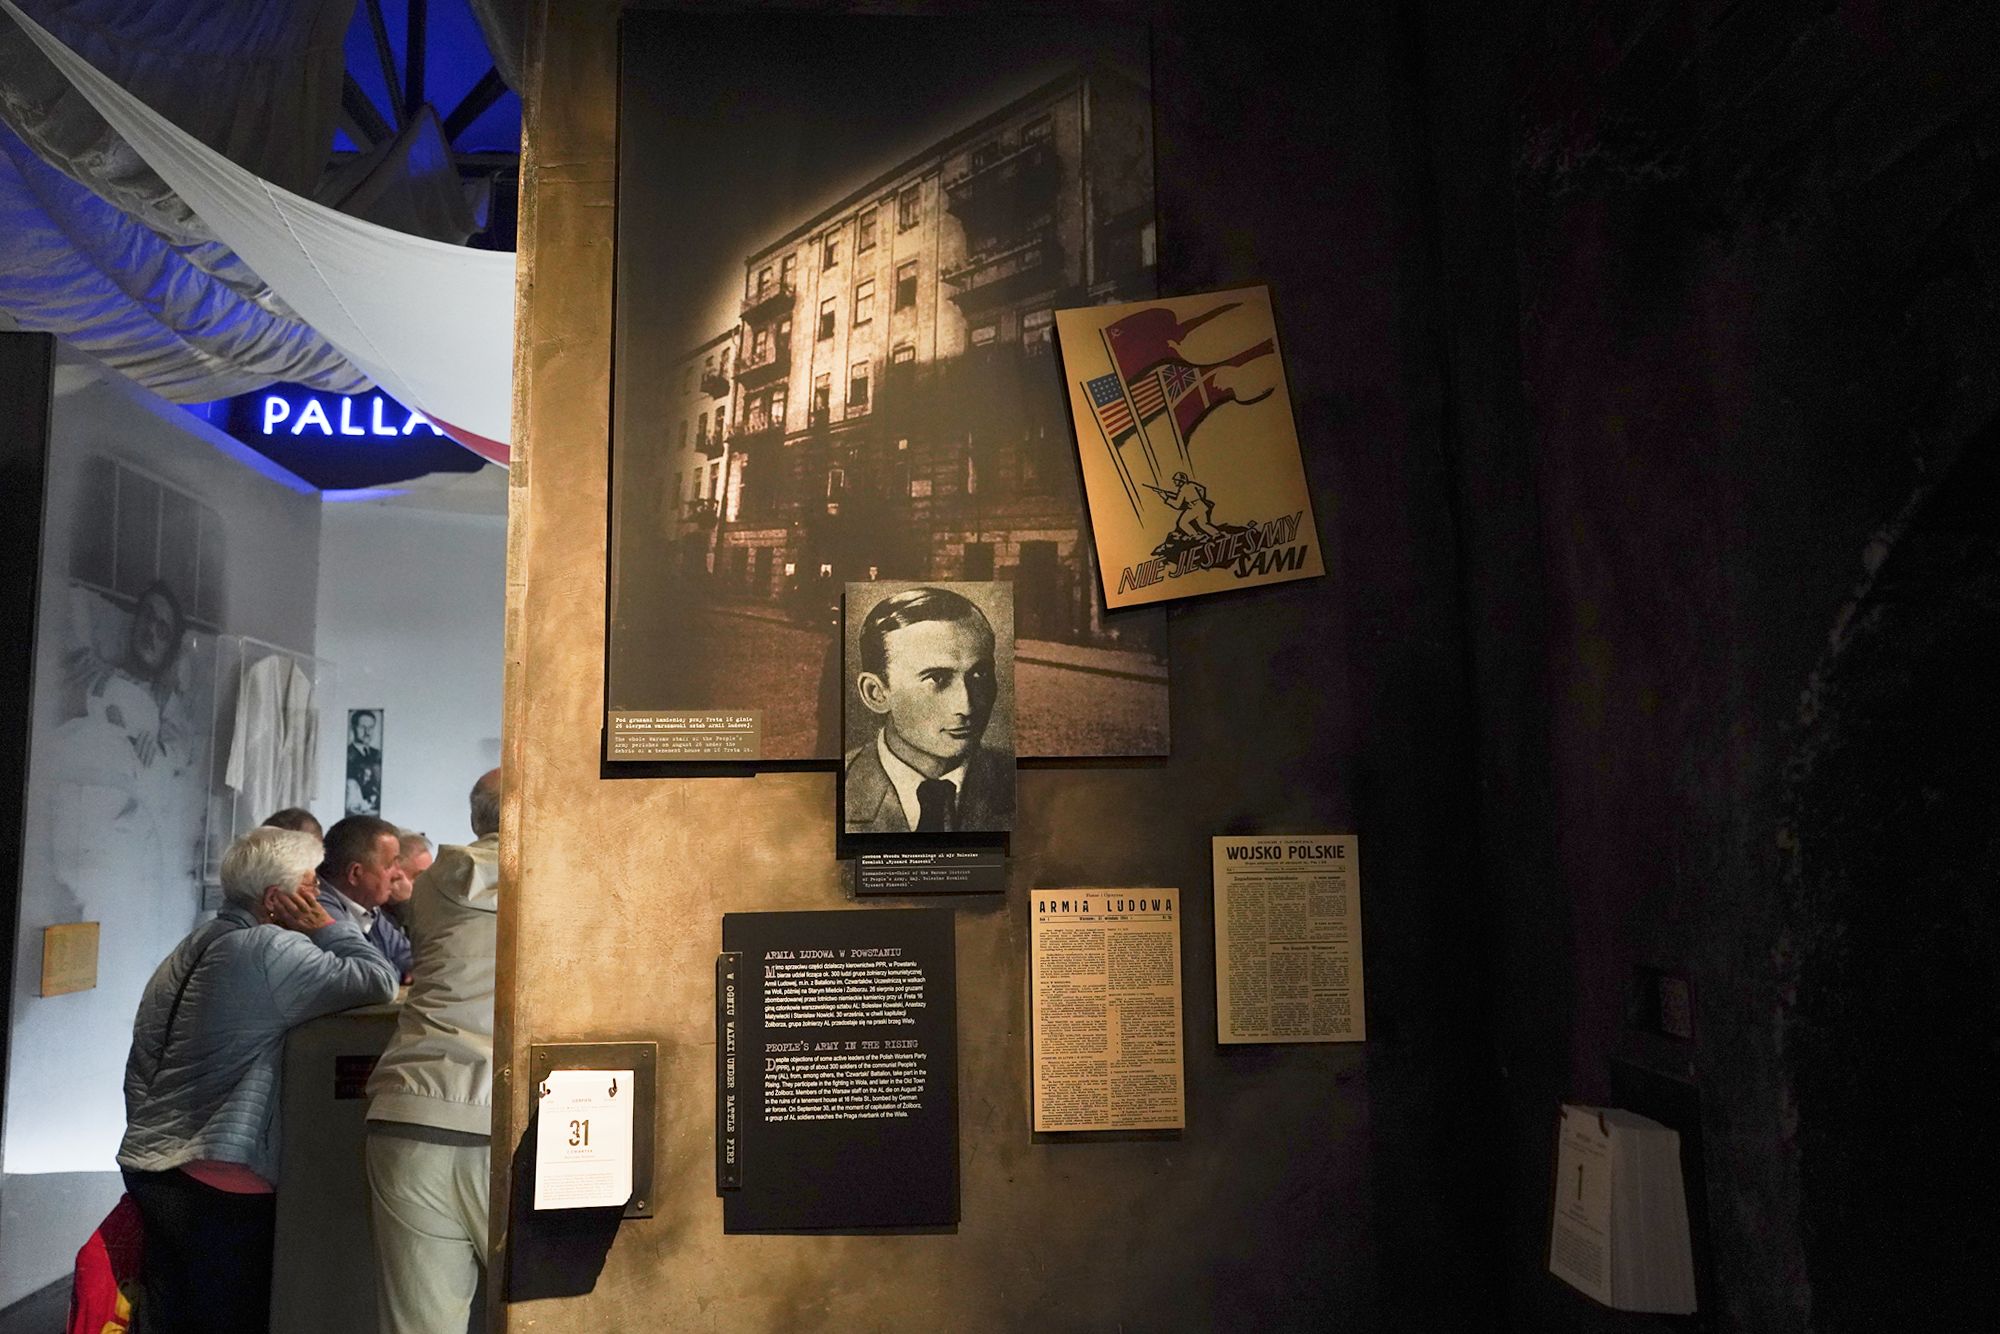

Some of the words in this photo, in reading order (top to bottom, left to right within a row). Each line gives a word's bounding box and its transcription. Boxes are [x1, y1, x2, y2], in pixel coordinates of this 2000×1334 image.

[1234, 545, 1308, 578] SAMI
[1117, 558, 1166, 595] NIE
[1226, 846, 1281, 860] WOJSKO
[1289, 845, 1345, 859] POLSKIE
[1039, 901, 1089, 913] ARMIA
[1107, 899, 1172, 912] LUDOWA
[764, 951, 795, 960] ARMIA
[800, 950, 834, 959] LUDOWA
[839, 950, 845, 958] W
[851, 948, 902, 958] POWSTANIU
[726, 985, 735, 1016] OGNIU
[765, 1041, 809, 1052] PEOPLE'S
[815, 1042, 838, 1050] ARMY
[845, 1042, 856, 1050] IN
[862, 1041, 879, 1049] THE
[885, 1040, 918, 1049] RISING
[726, 1095, 735, 1132] BATTLE
[569, 1120, 589, 1146] 31
[726, 1138, 735, 1164] FIRE
